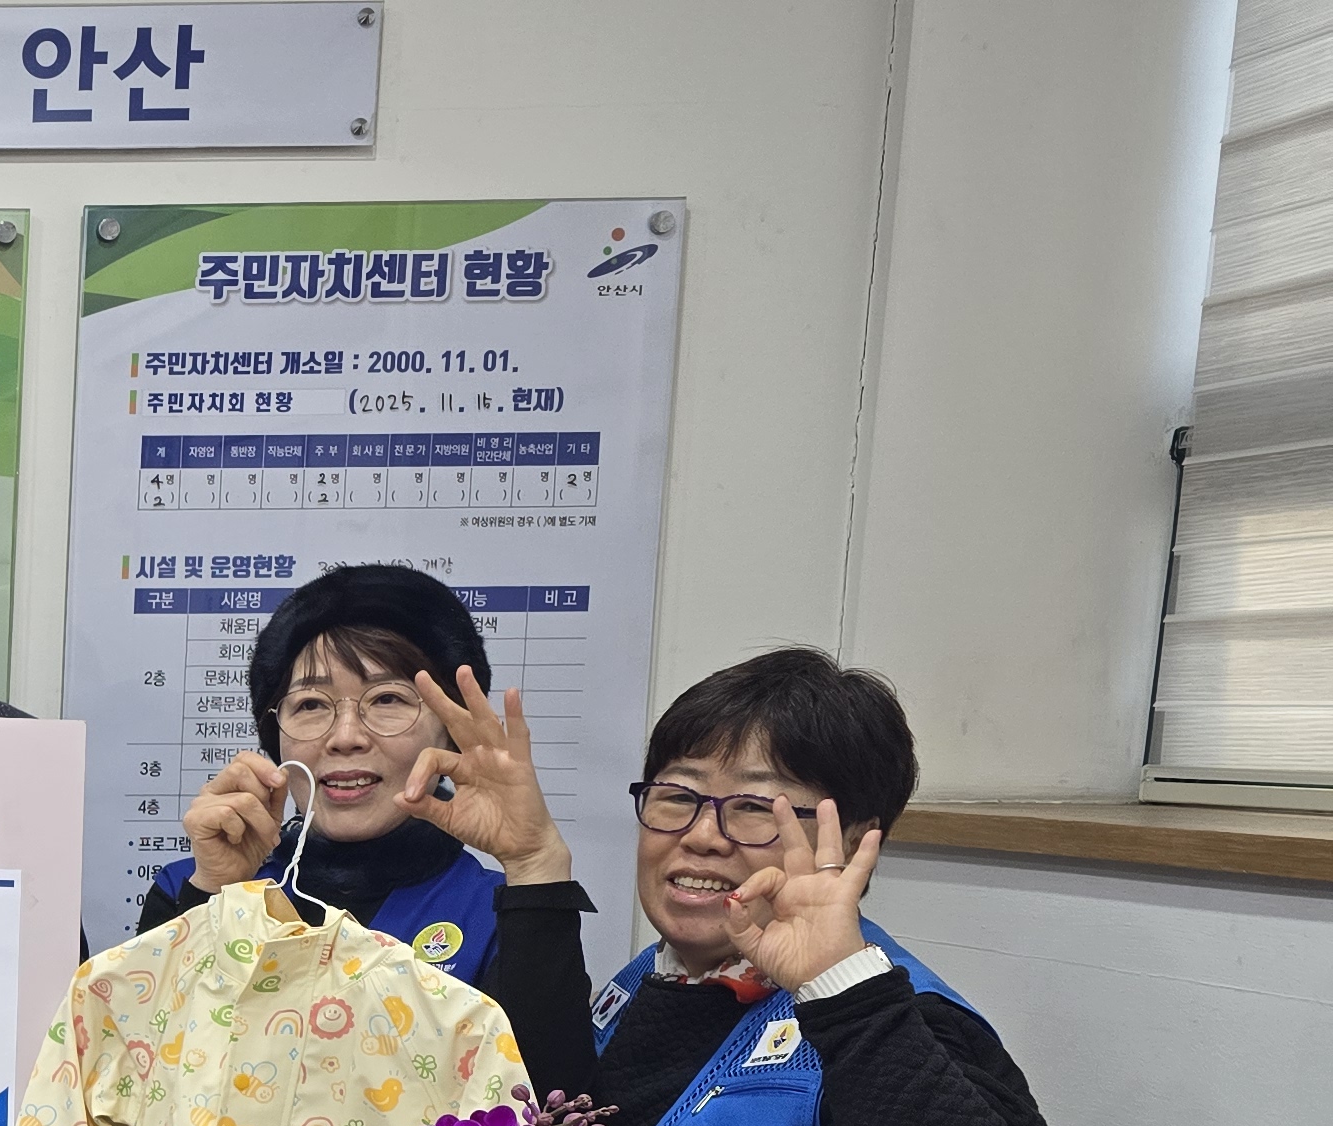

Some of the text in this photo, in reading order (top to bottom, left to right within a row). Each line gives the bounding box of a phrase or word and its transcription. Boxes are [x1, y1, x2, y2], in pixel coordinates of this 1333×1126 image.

[22, 24, 204, 122] 안산
[199, 250, 550, 300] 주민자치센터 현황
[597, 284, 643, 296] 안산시
[145, 350, 518, 376] 주민자치센터 개소일 2000. 11. 01.
[147, 386, 564, 413] 주민자치회 현황 현재)
[517, 517, 534, 527] 경우
[579, 516, 596, 527] 기재
[135, 556, 176, 579] 시설
[185, 556, 204, 579] 및
[211, 555, 296, 579] 운영현황
[147, 592, 261, 608] 구분 시설명
[220, 618, 259, 634] 채움터
[145, 671, 166, 686] 2층
[140, 762, 161, 777] 3층
[138, 800, 160, 815] 4층
